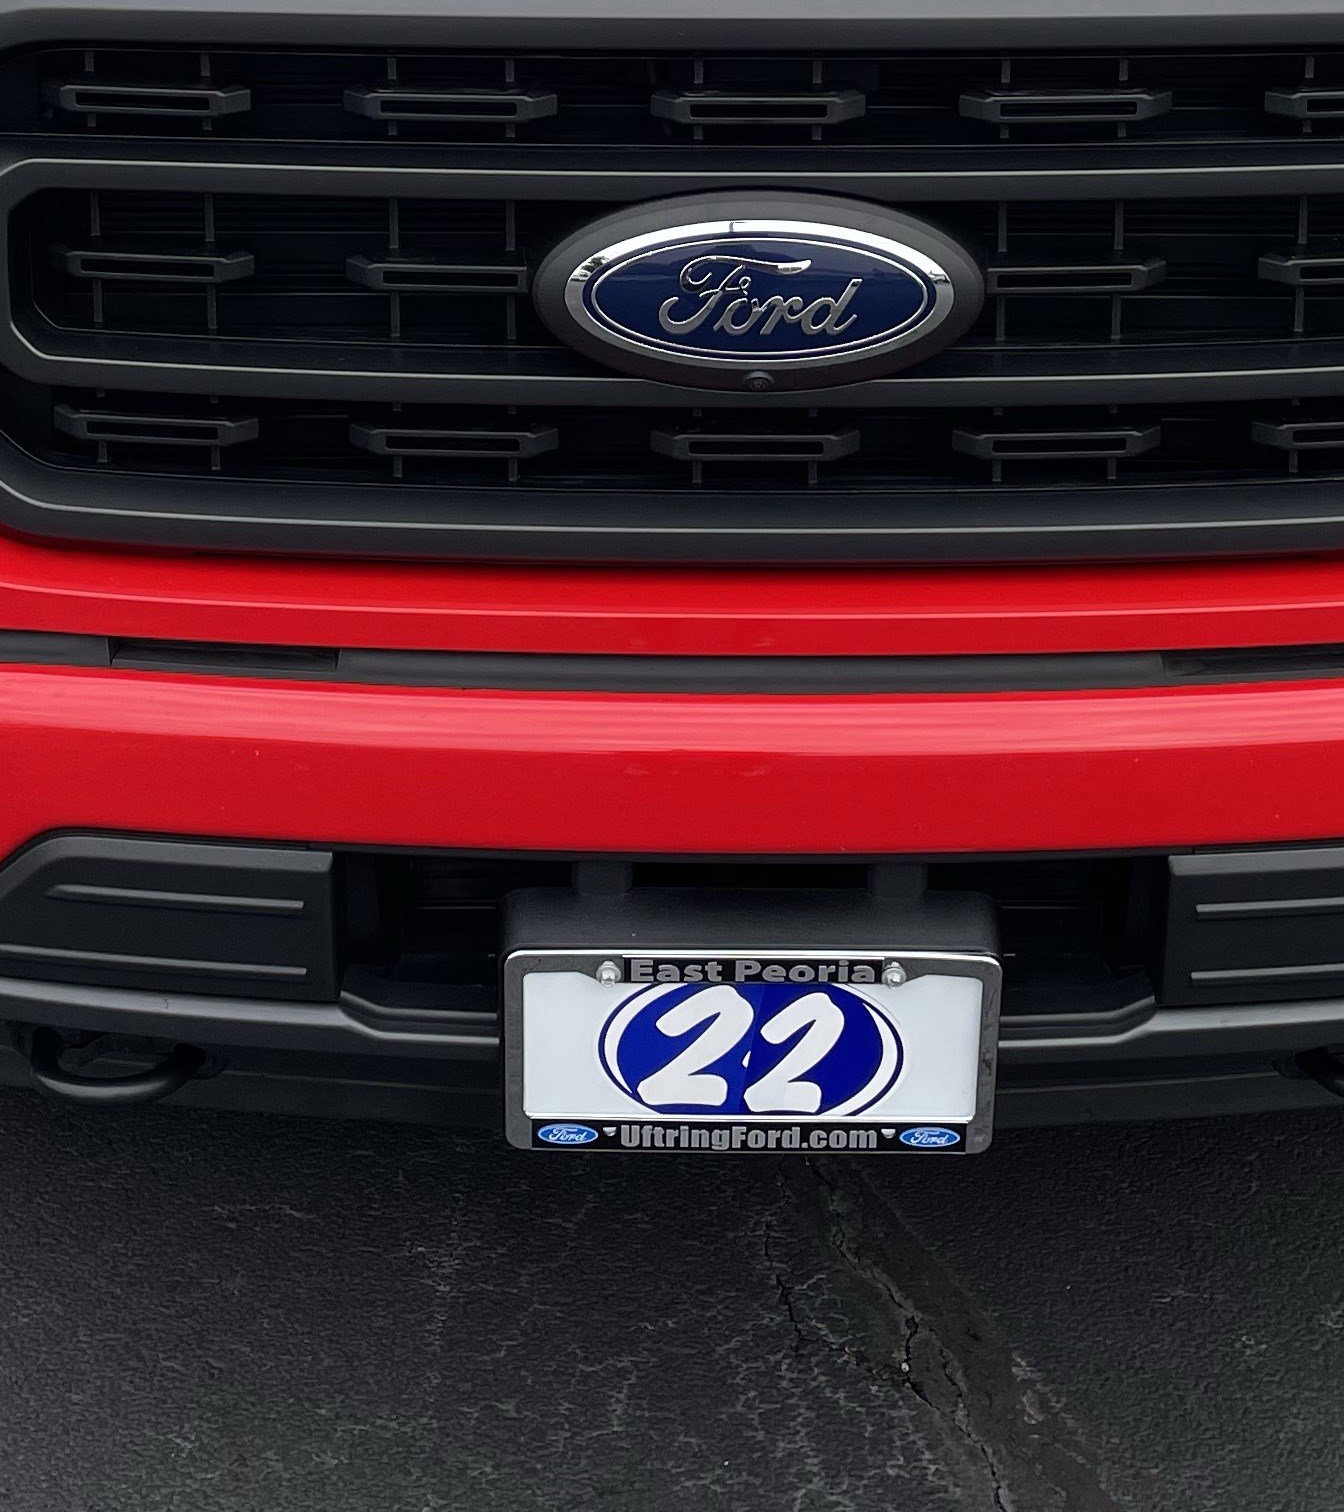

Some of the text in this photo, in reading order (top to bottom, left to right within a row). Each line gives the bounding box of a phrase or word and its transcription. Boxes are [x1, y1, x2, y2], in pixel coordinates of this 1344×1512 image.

[658, 255, 863, 336] Ford
[630, 959, 876, 984] East Peoria
[636, 985, 845, 1114] 22
[549, 1126, 587, 1142] Ford
[620, 1124, 877, 1150] UftringFord.com
[910, 1130, 950, 1146] Ford
